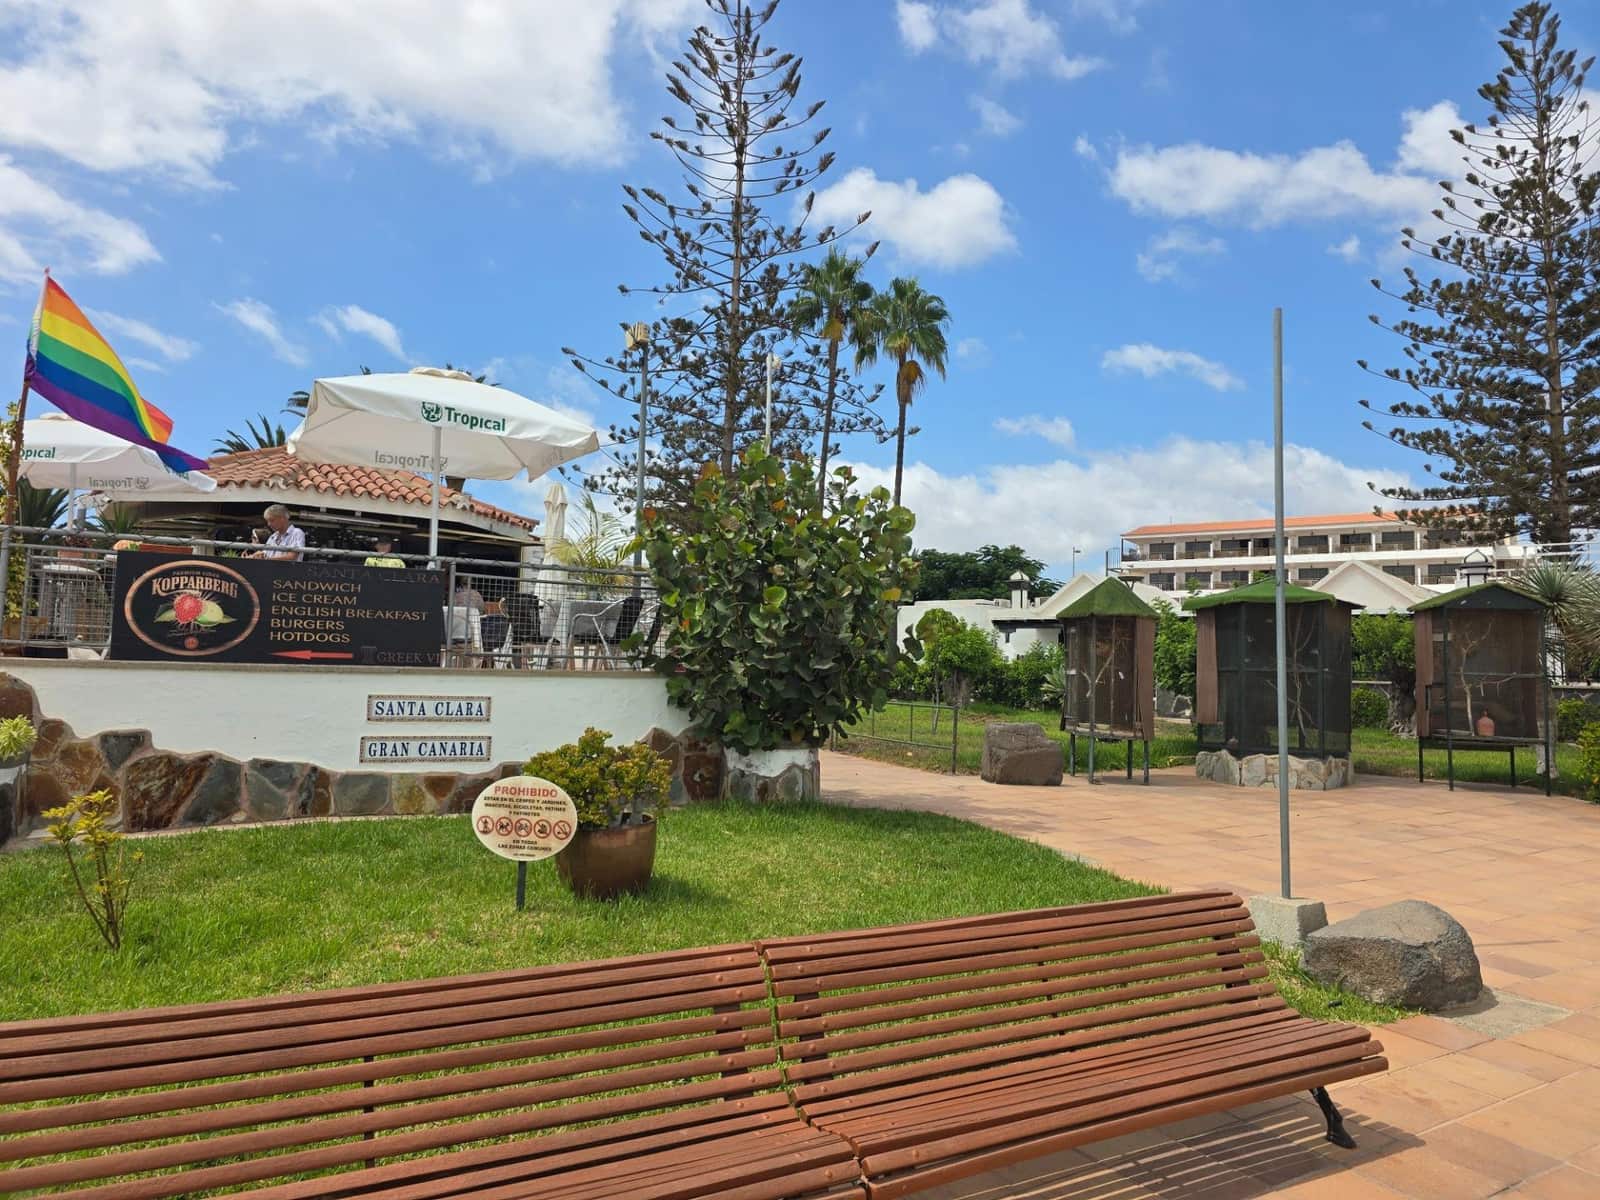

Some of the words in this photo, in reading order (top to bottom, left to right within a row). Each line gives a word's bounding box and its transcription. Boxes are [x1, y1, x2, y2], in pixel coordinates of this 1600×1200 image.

[445, 406, 506, 432] Tropical
[20, 446, 56, 460] opical
[152, 575, 238, 598] KOPPARBERG
[273, 579, 361, 593] SANDWICH
[272, 592, 296, 603] ICE
[302, 593, 357, 605] CREAM
[271, 605, 341, 617] ENGLISH
[346, 608, 428, 621] BREAKFAST
[271, 618, 345, 630] BURGERS
[270, 631, 350, 643] HOTDOGS
[377, 651, 425, 664] GREEK
[375, 701, 426, 716] SANTA
[435, 702, 484, 716] CLARA
[368, 742, 410, 757] GRAN
[418, 742, 484, 757] CANARIA
[494, 785, 558, 798] PROHIBIDO
